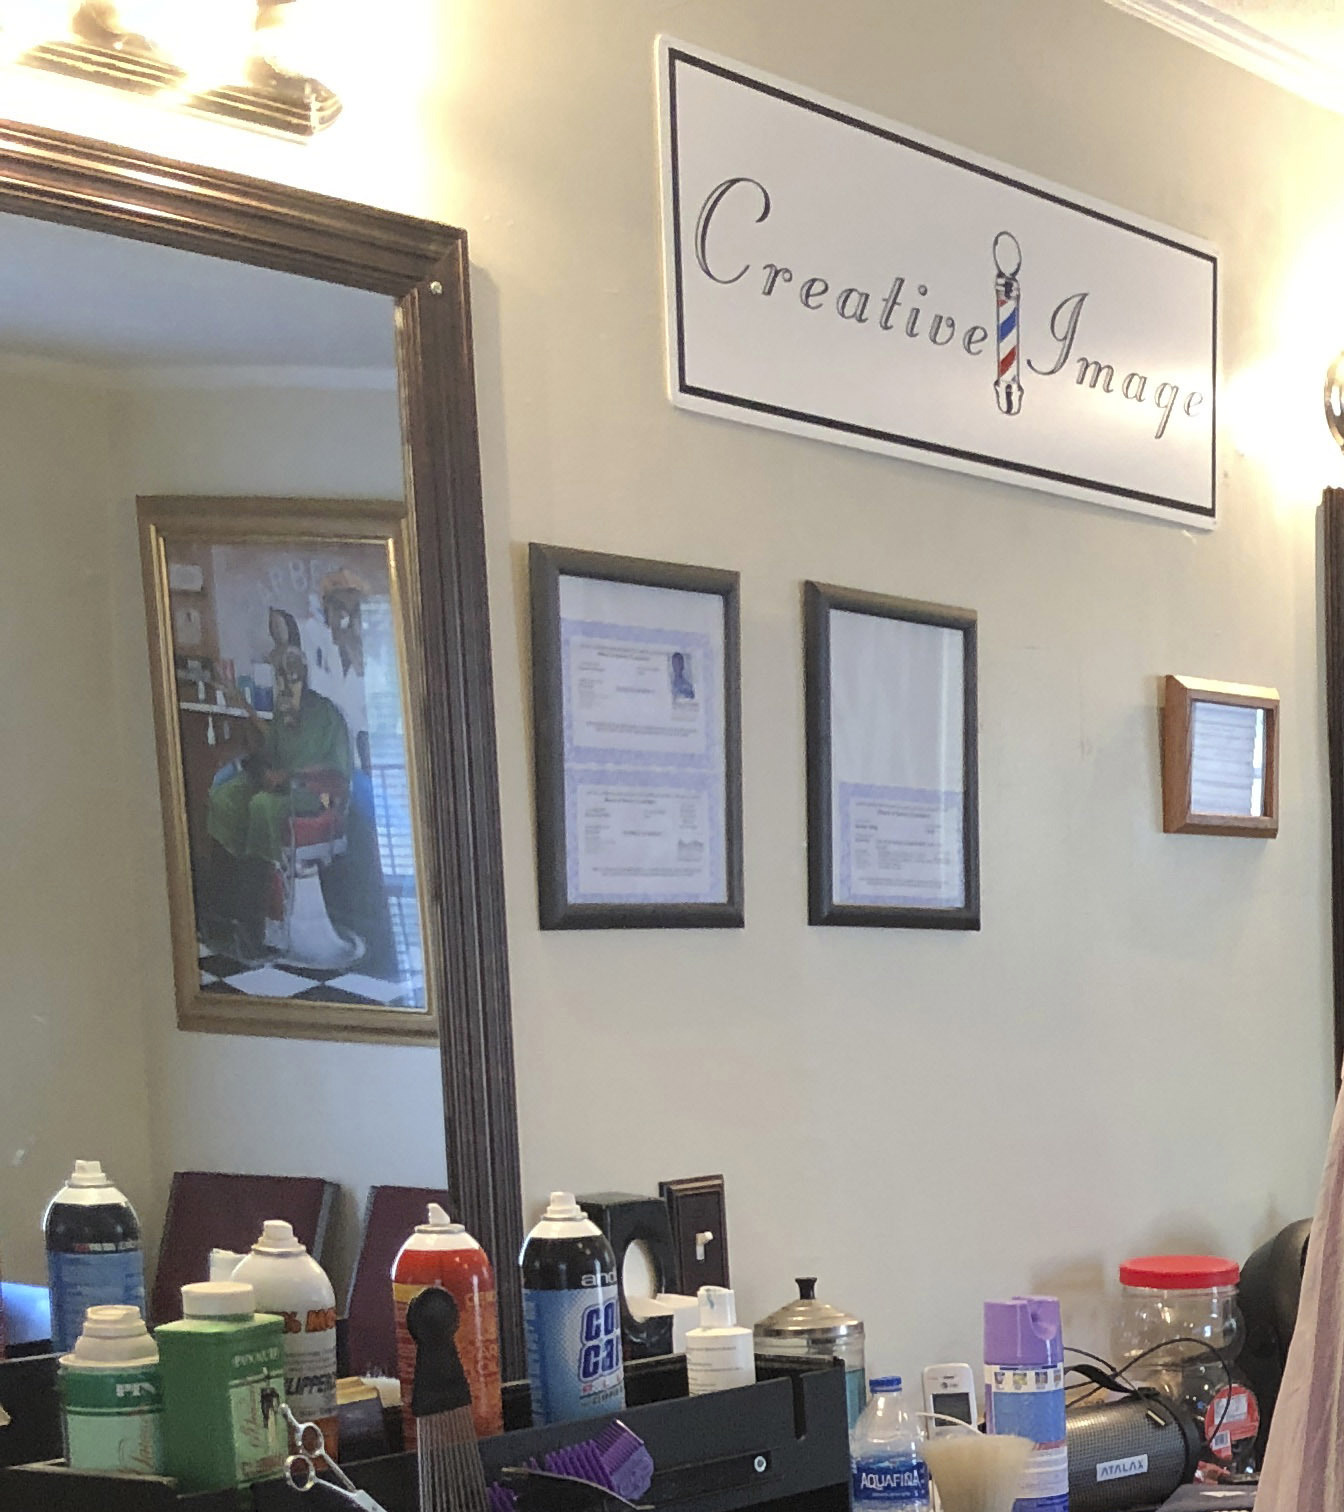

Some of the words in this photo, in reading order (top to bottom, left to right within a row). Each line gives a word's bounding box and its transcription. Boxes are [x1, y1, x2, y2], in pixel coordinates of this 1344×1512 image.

[695, 177, 988, 356] Creative
[1026, 293, 1204, 439] Image
[1100, 1459, 1145, 1477] ATALAX
[860, 1469, 922, 1490] AQUAFINA
